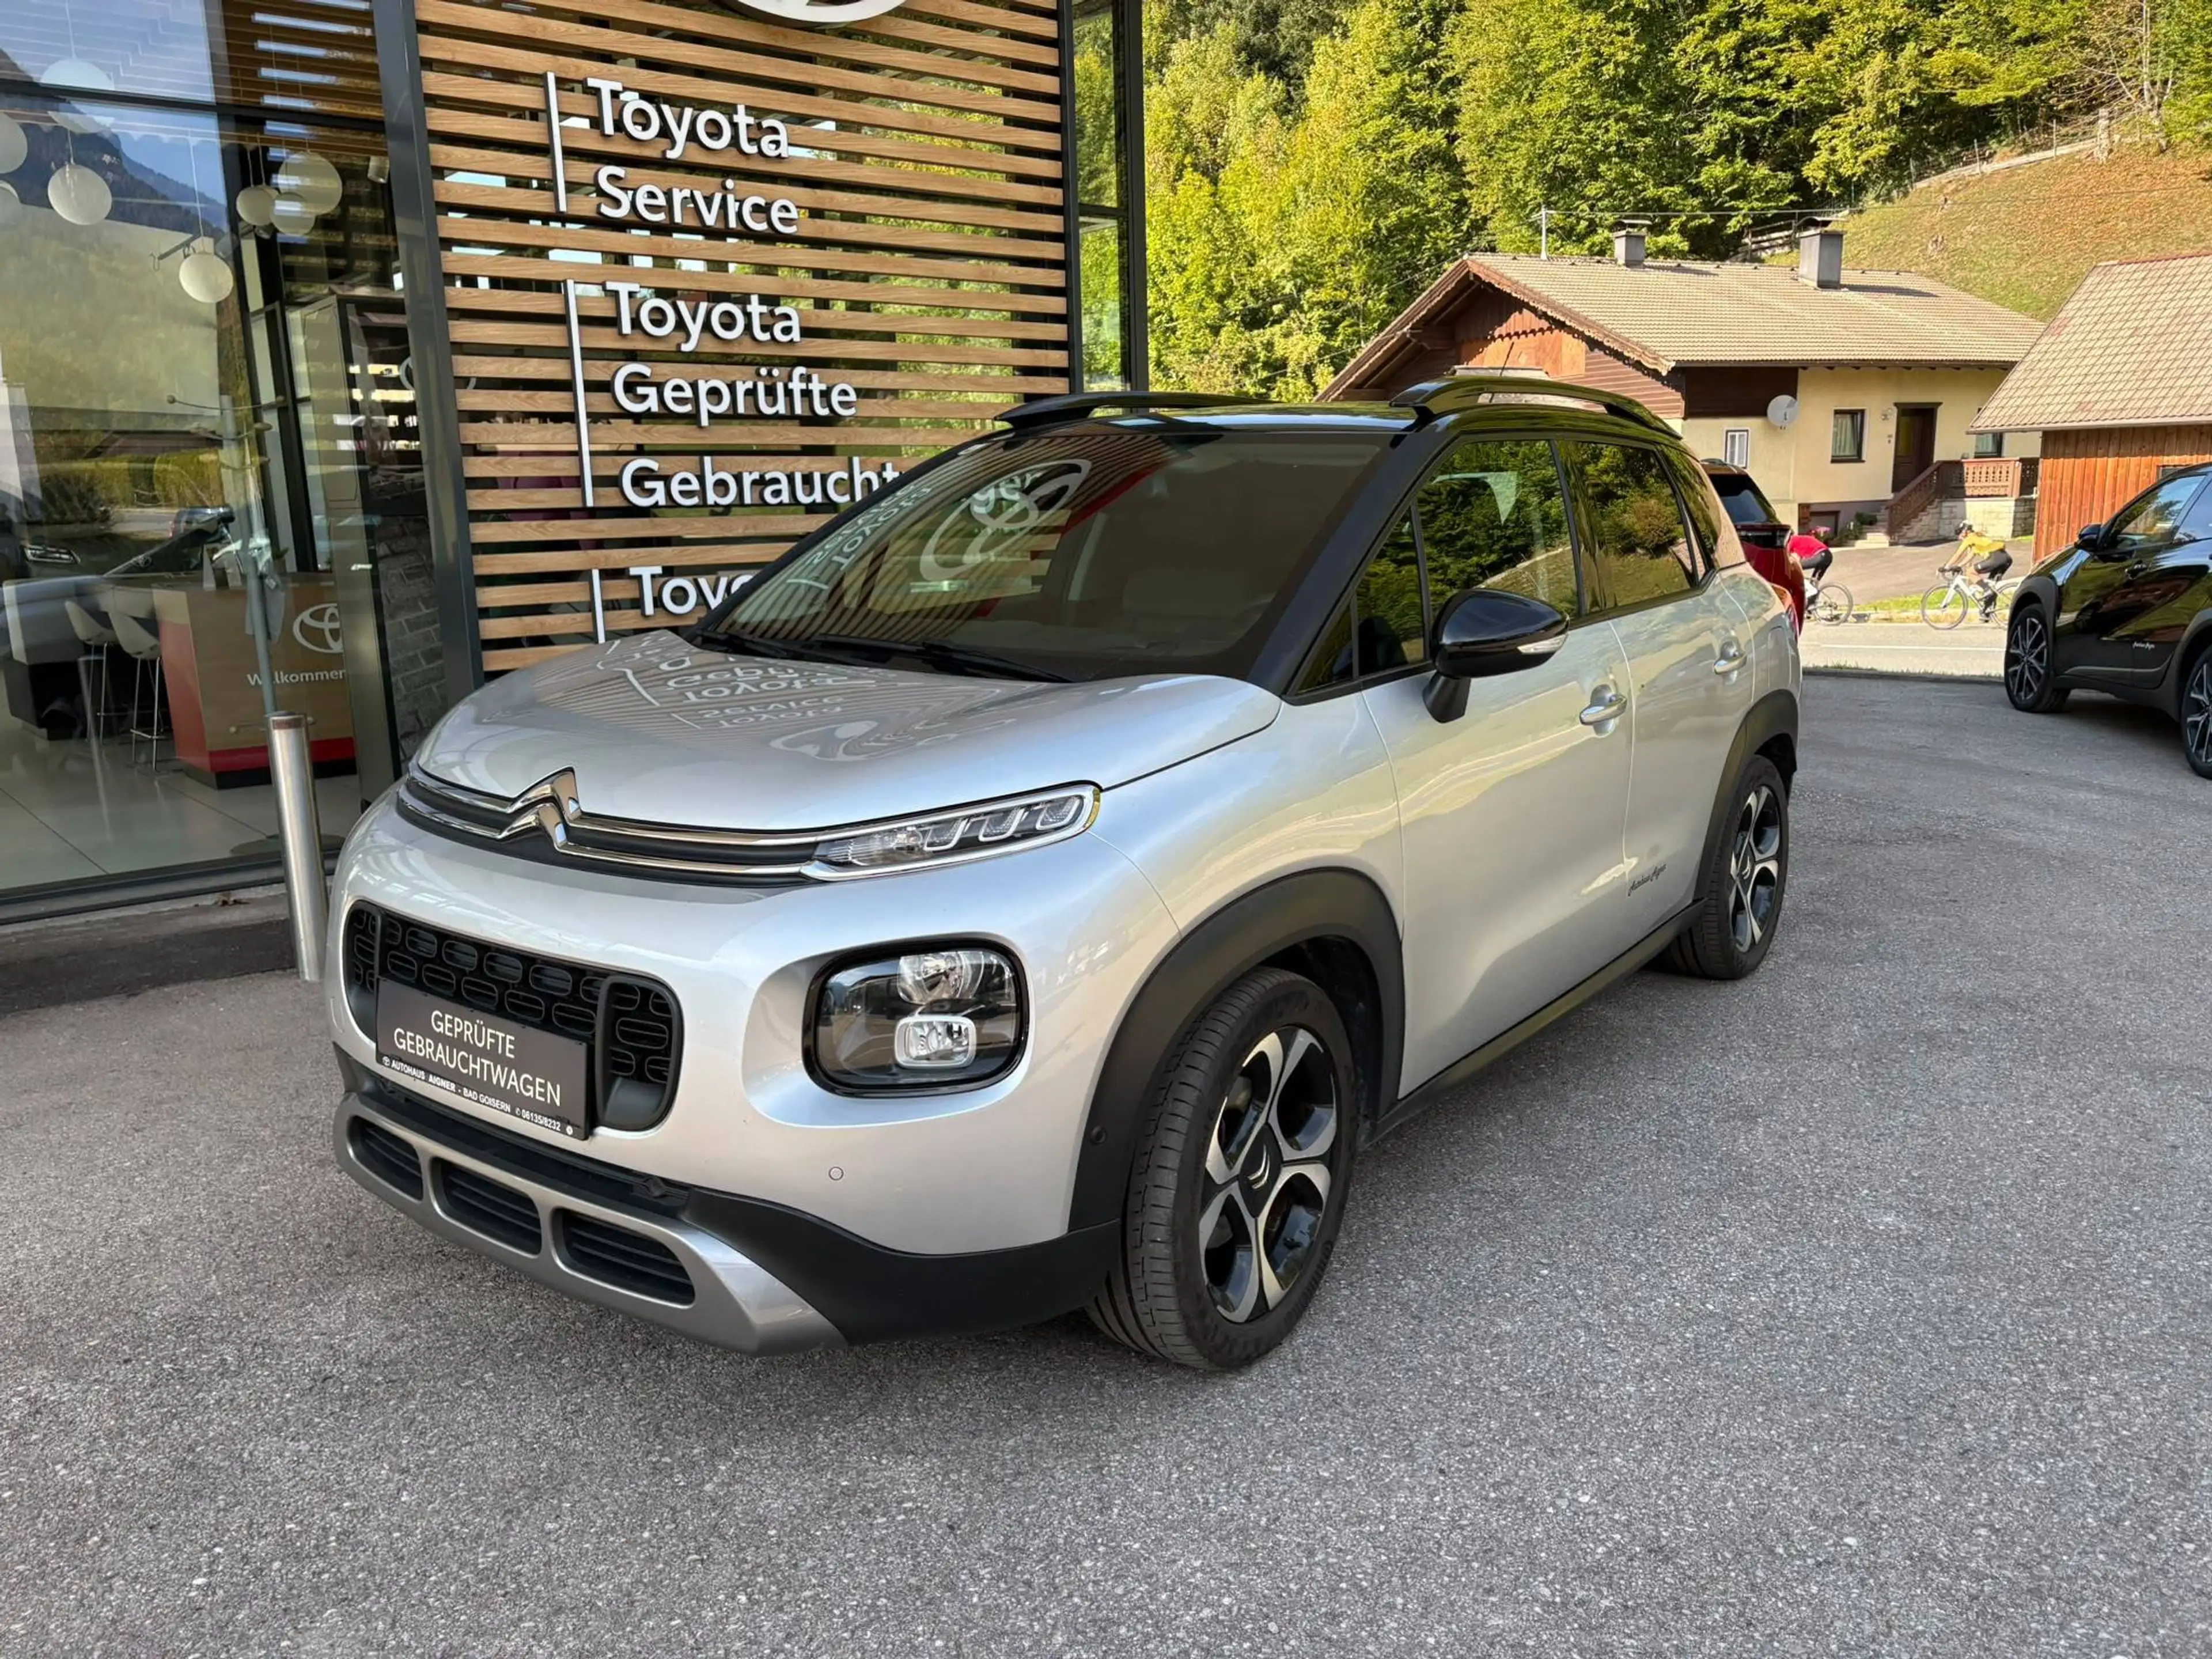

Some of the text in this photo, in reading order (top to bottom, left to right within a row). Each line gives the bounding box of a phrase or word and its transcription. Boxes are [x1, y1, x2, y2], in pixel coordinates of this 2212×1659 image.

[584, 77, 789, 159] Toyota
[596, 165, 798, 234] Service
[605, 281, 800, 353] Toyota
[613, 363, 857, 427] Geprüfte
[620, 456, 904, 507] Gebraucht
[393, 1028, 561, 1107] GEBRAUCHTWAGEN
[430, 1010, 515, 1059] GEPRÜFTE
[391, 1059, 425, 1080] AUTOHAUS
[429, 1074, 456, 1093] AIGNER
[463, 1087, 478, 1101] BAD
[479, 1093, 511, 1113] GOISERN
